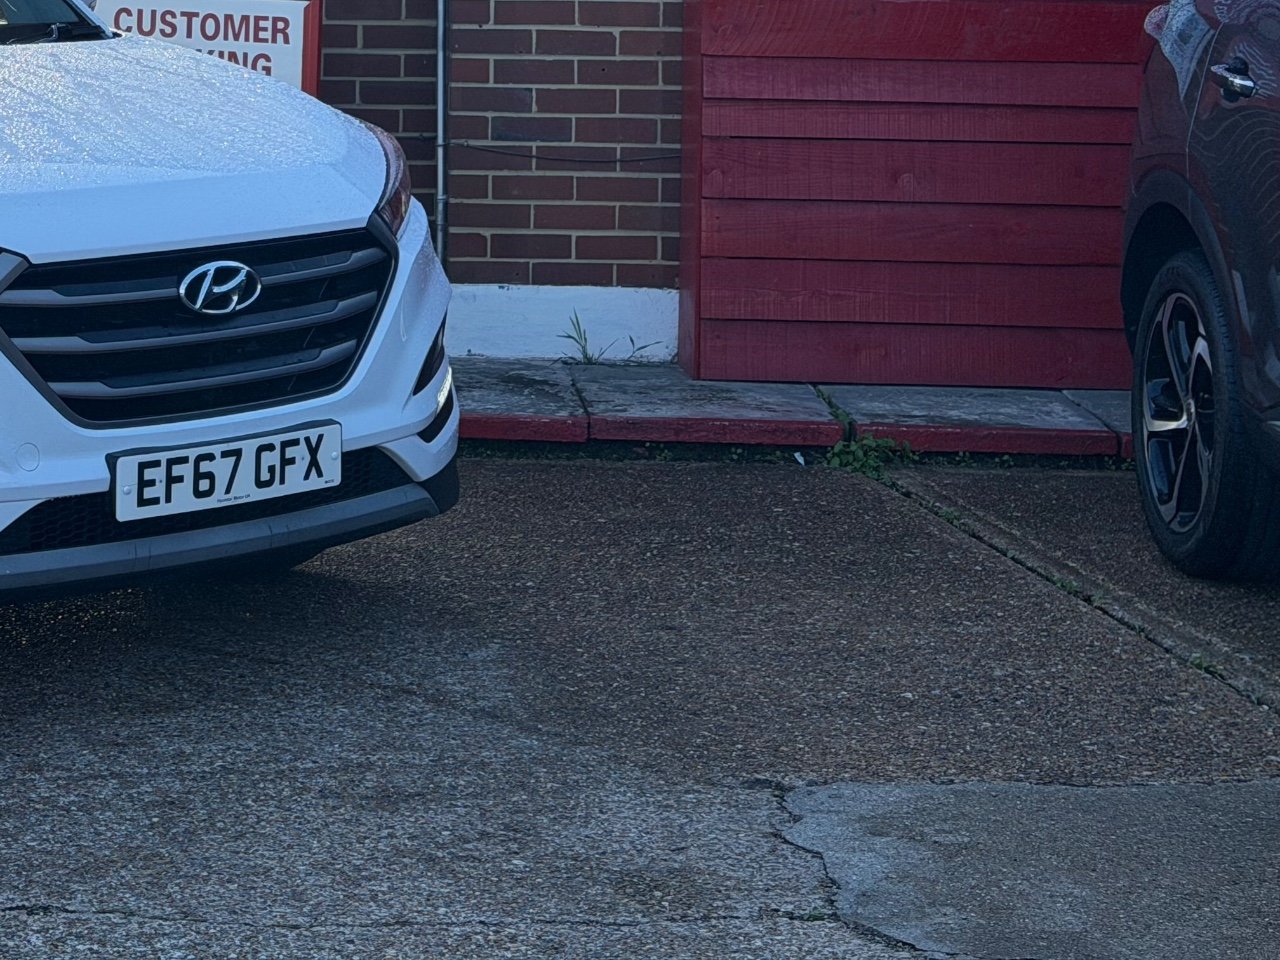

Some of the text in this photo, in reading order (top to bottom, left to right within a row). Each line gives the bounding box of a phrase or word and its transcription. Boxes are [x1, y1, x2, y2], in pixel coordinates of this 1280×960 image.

[113, 7, 291, 45] CUSTOMER
[136, 433, 325, 508] EF67 GFX
